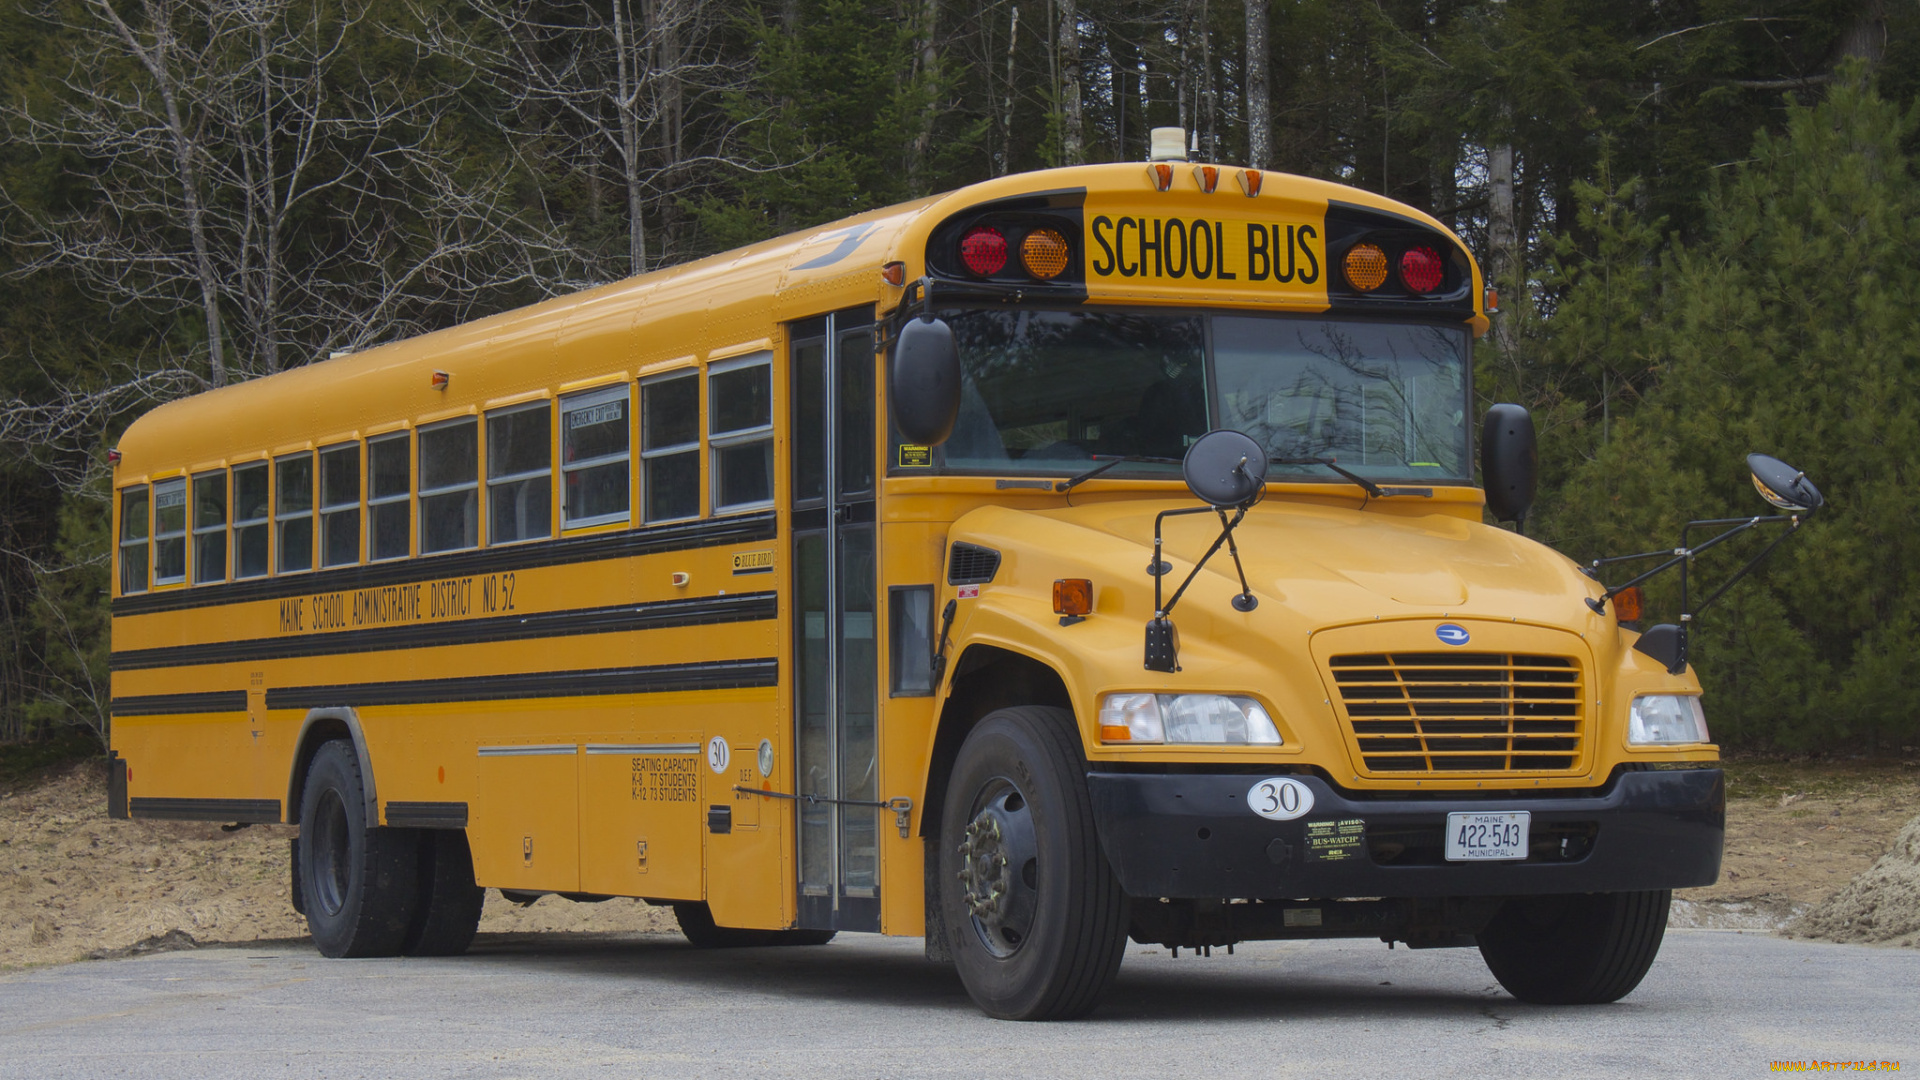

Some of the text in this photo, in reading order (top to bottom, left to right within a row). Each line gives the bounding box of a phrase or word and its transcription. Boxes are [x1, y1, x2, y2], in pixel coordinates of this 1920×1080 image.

[1091, 215, 1320, 285] SCHOOL BUS
[279, 598, 304, 632] MAINE
[312, 593, 346, 630] SCHOOL
[352, 584, 421, 626] ADMINISTRATIVE
[430, 578, 473, 618] DISTRICT
[502, 572, 516, 611] 52
[712, 741, 726, 767] 30
[632, 757, 699, 773] SEATING CAPACITY
[631, 772, 697, 788] K-8 77 STUDENTS
[631, 786, 697, 802] K-12 73 STUDENTS
[1260, 782, 1301, 814] 30
[1475, 815, 1504, 824] MAINE
[1468, 848, 1511, 857] MUNICIPAL
